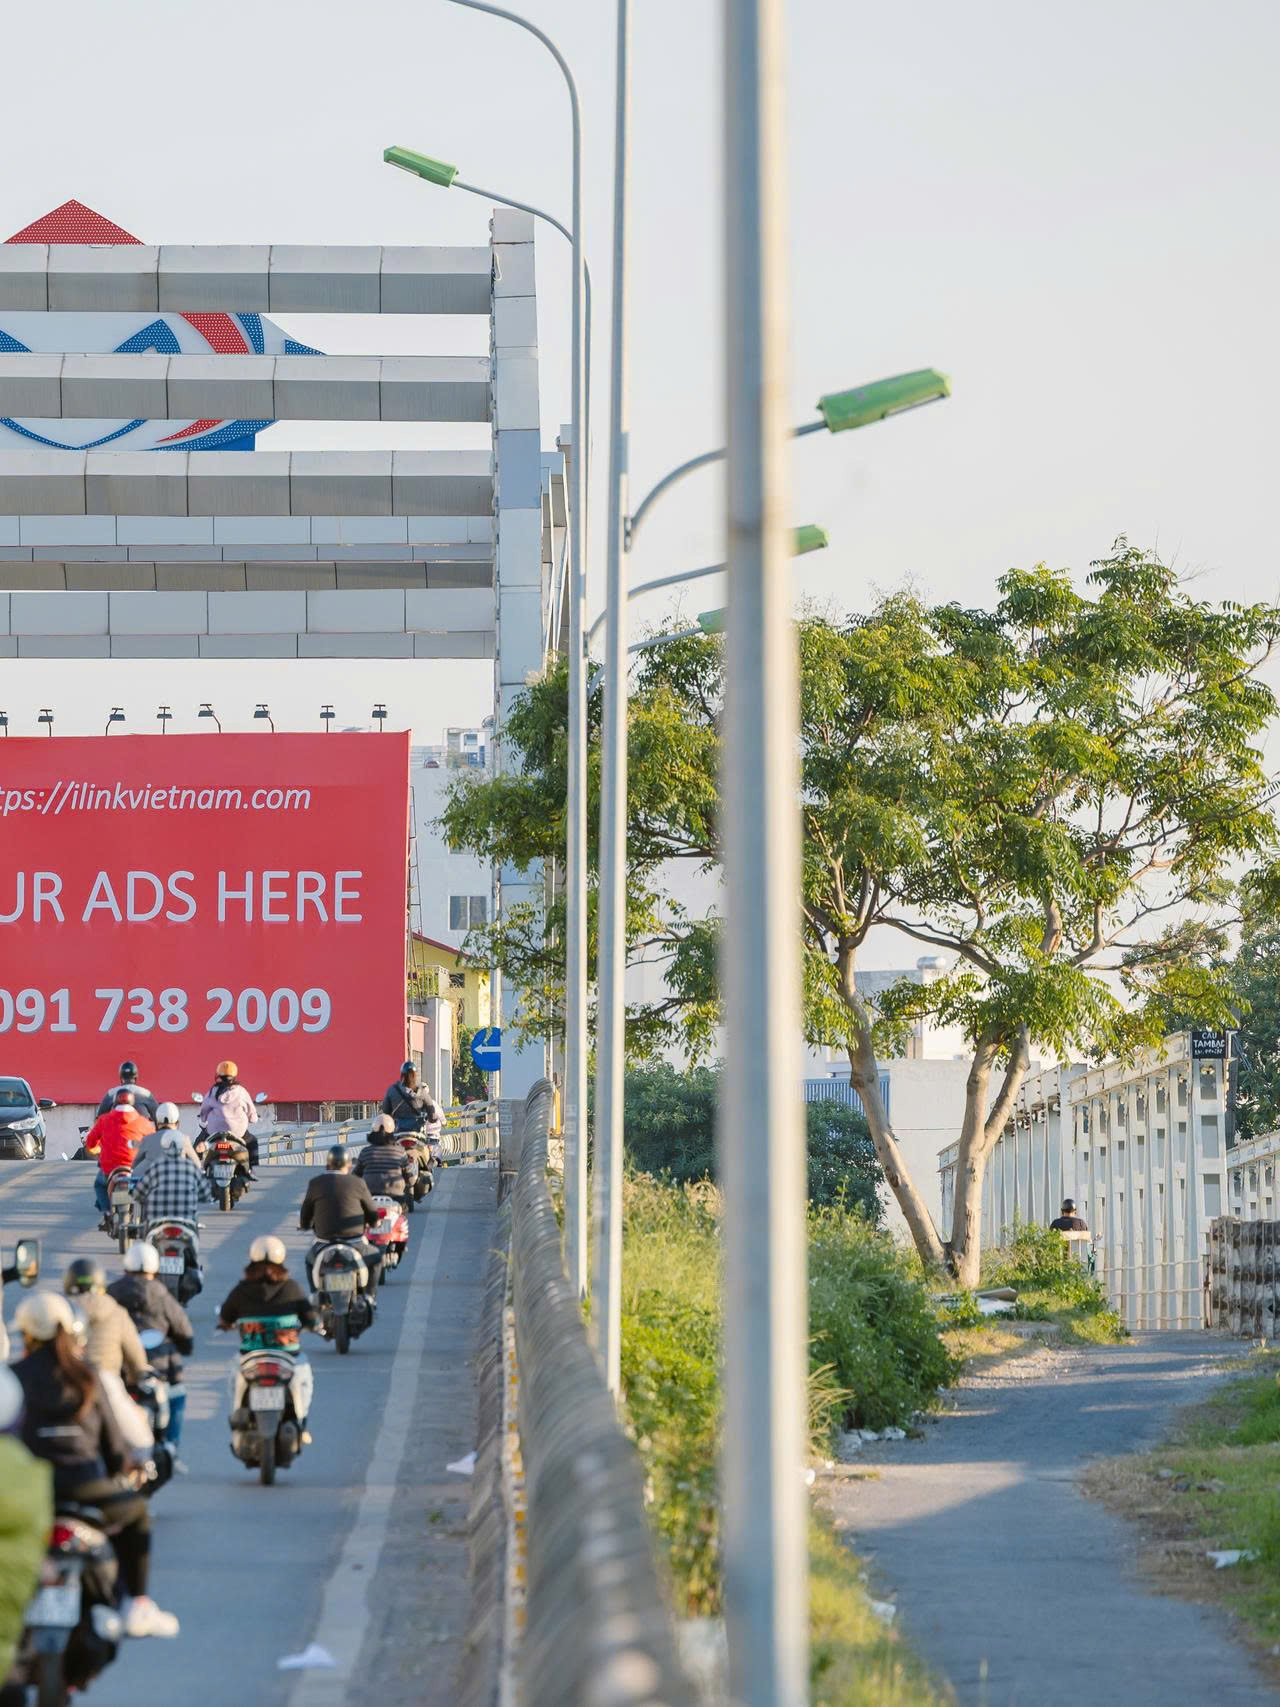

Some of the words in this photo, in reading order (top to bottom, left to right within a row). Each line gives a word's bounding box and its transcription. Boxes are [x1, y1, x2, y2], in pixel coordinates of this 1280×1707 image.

[82, 870, 197, 923] ADS
[217, 870, 363, 923] HERE
[95, 987, 189, 1033] 738
[206, 987, 332, 1033] 2009
